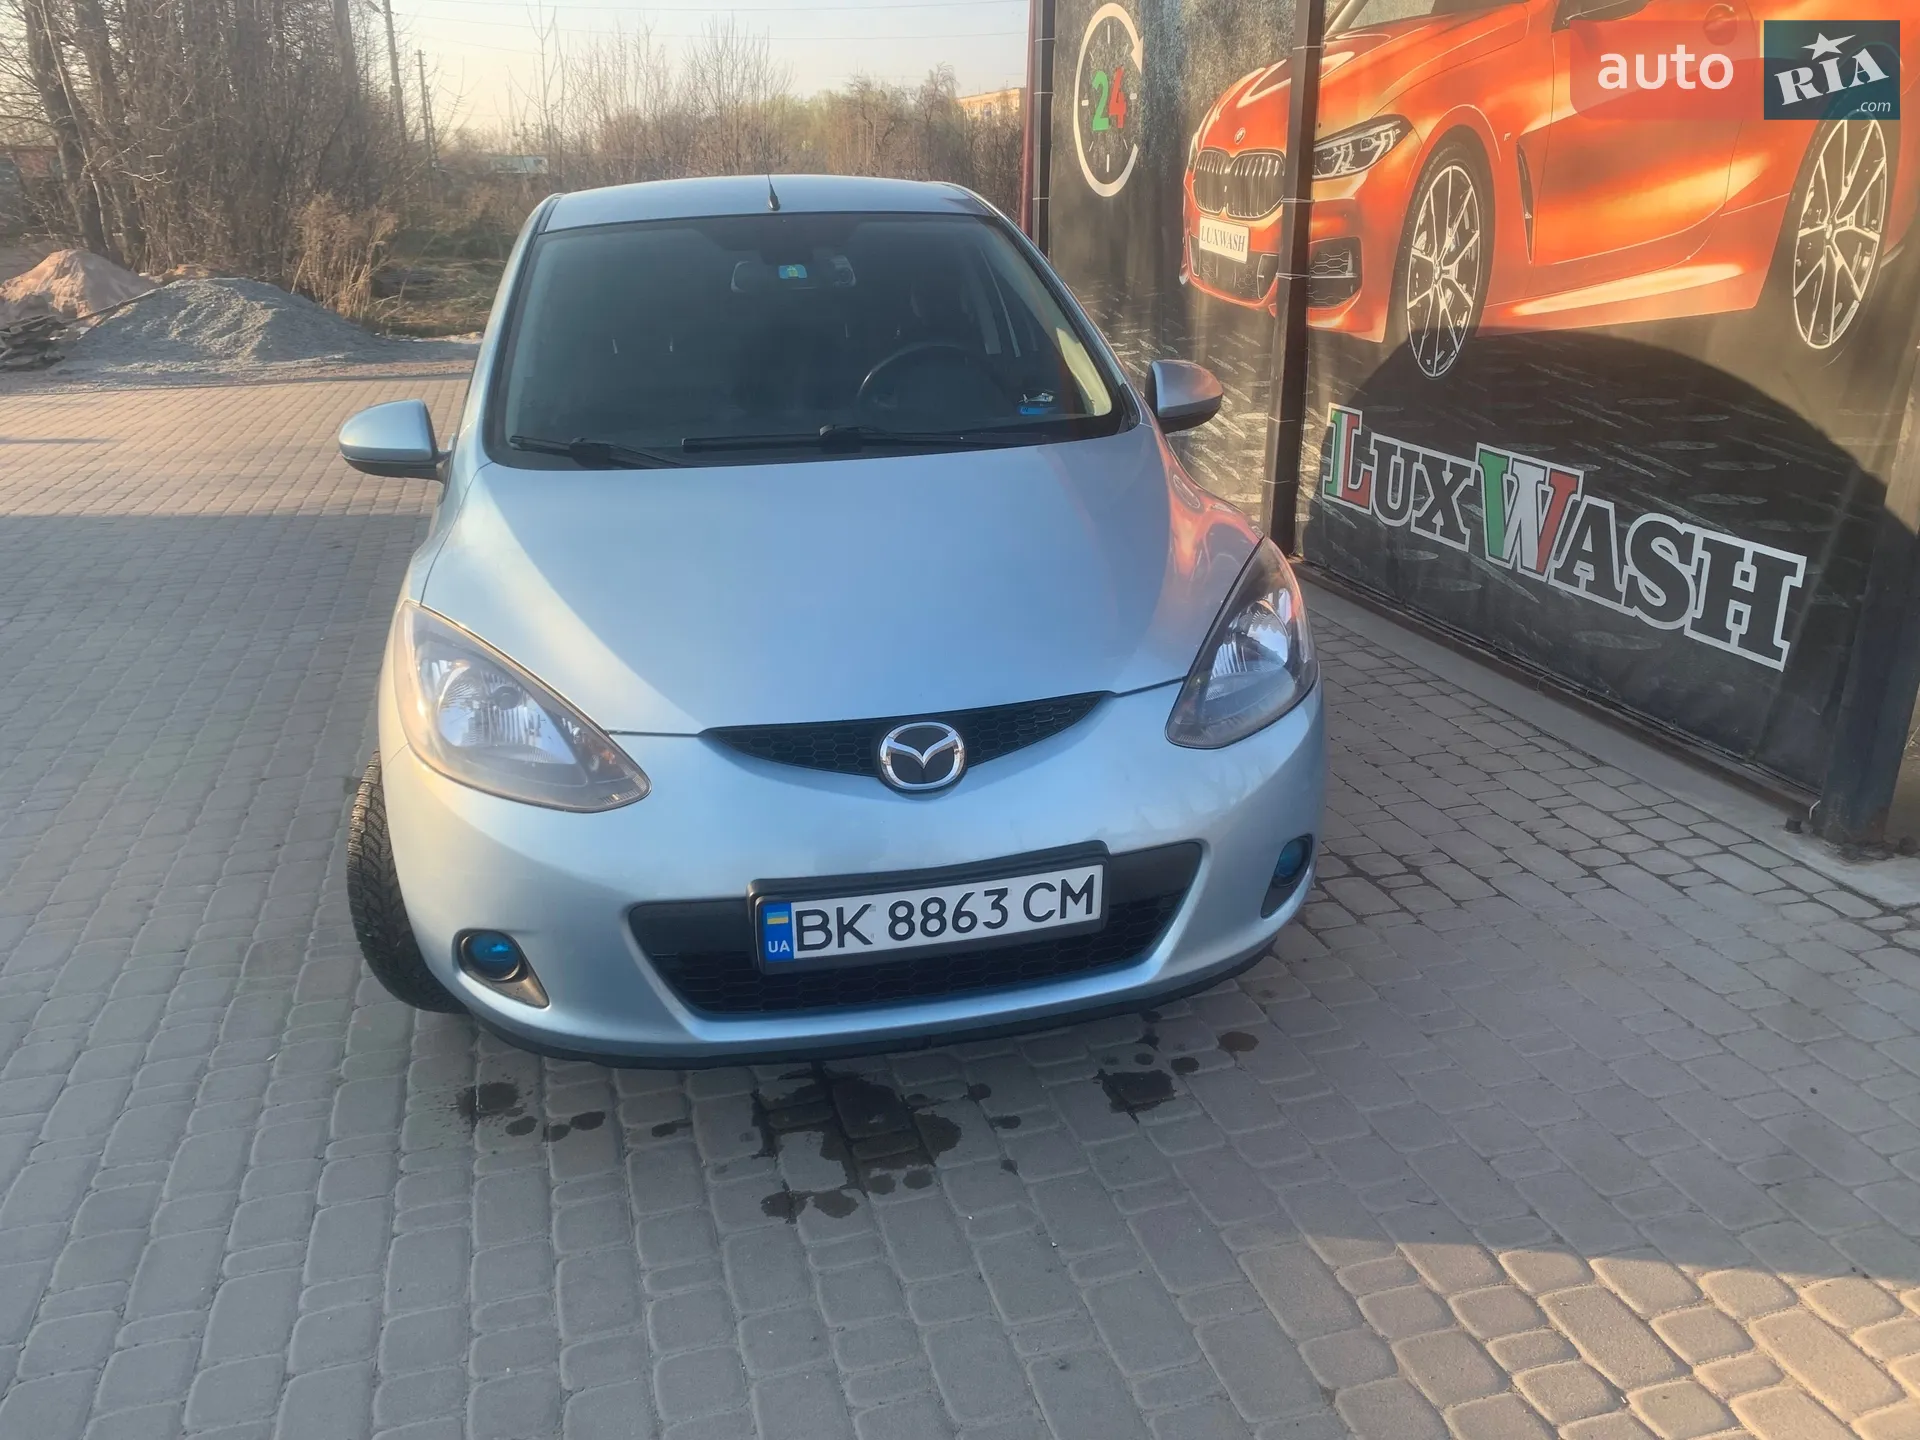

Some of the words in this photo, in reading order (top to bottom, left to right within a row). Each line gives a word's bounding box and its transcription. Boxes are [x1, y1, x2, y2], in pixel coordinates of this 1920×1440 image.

[1091, 66, 1127, 132] 24
[1201, 225, 1246, 253] LUXWASH
[795, 903, 874, 952] BK
[888, 887, 1009, 941] 8863
[1023, 874, 1095, 922] CM
[768, 940, 791, 953] UA
